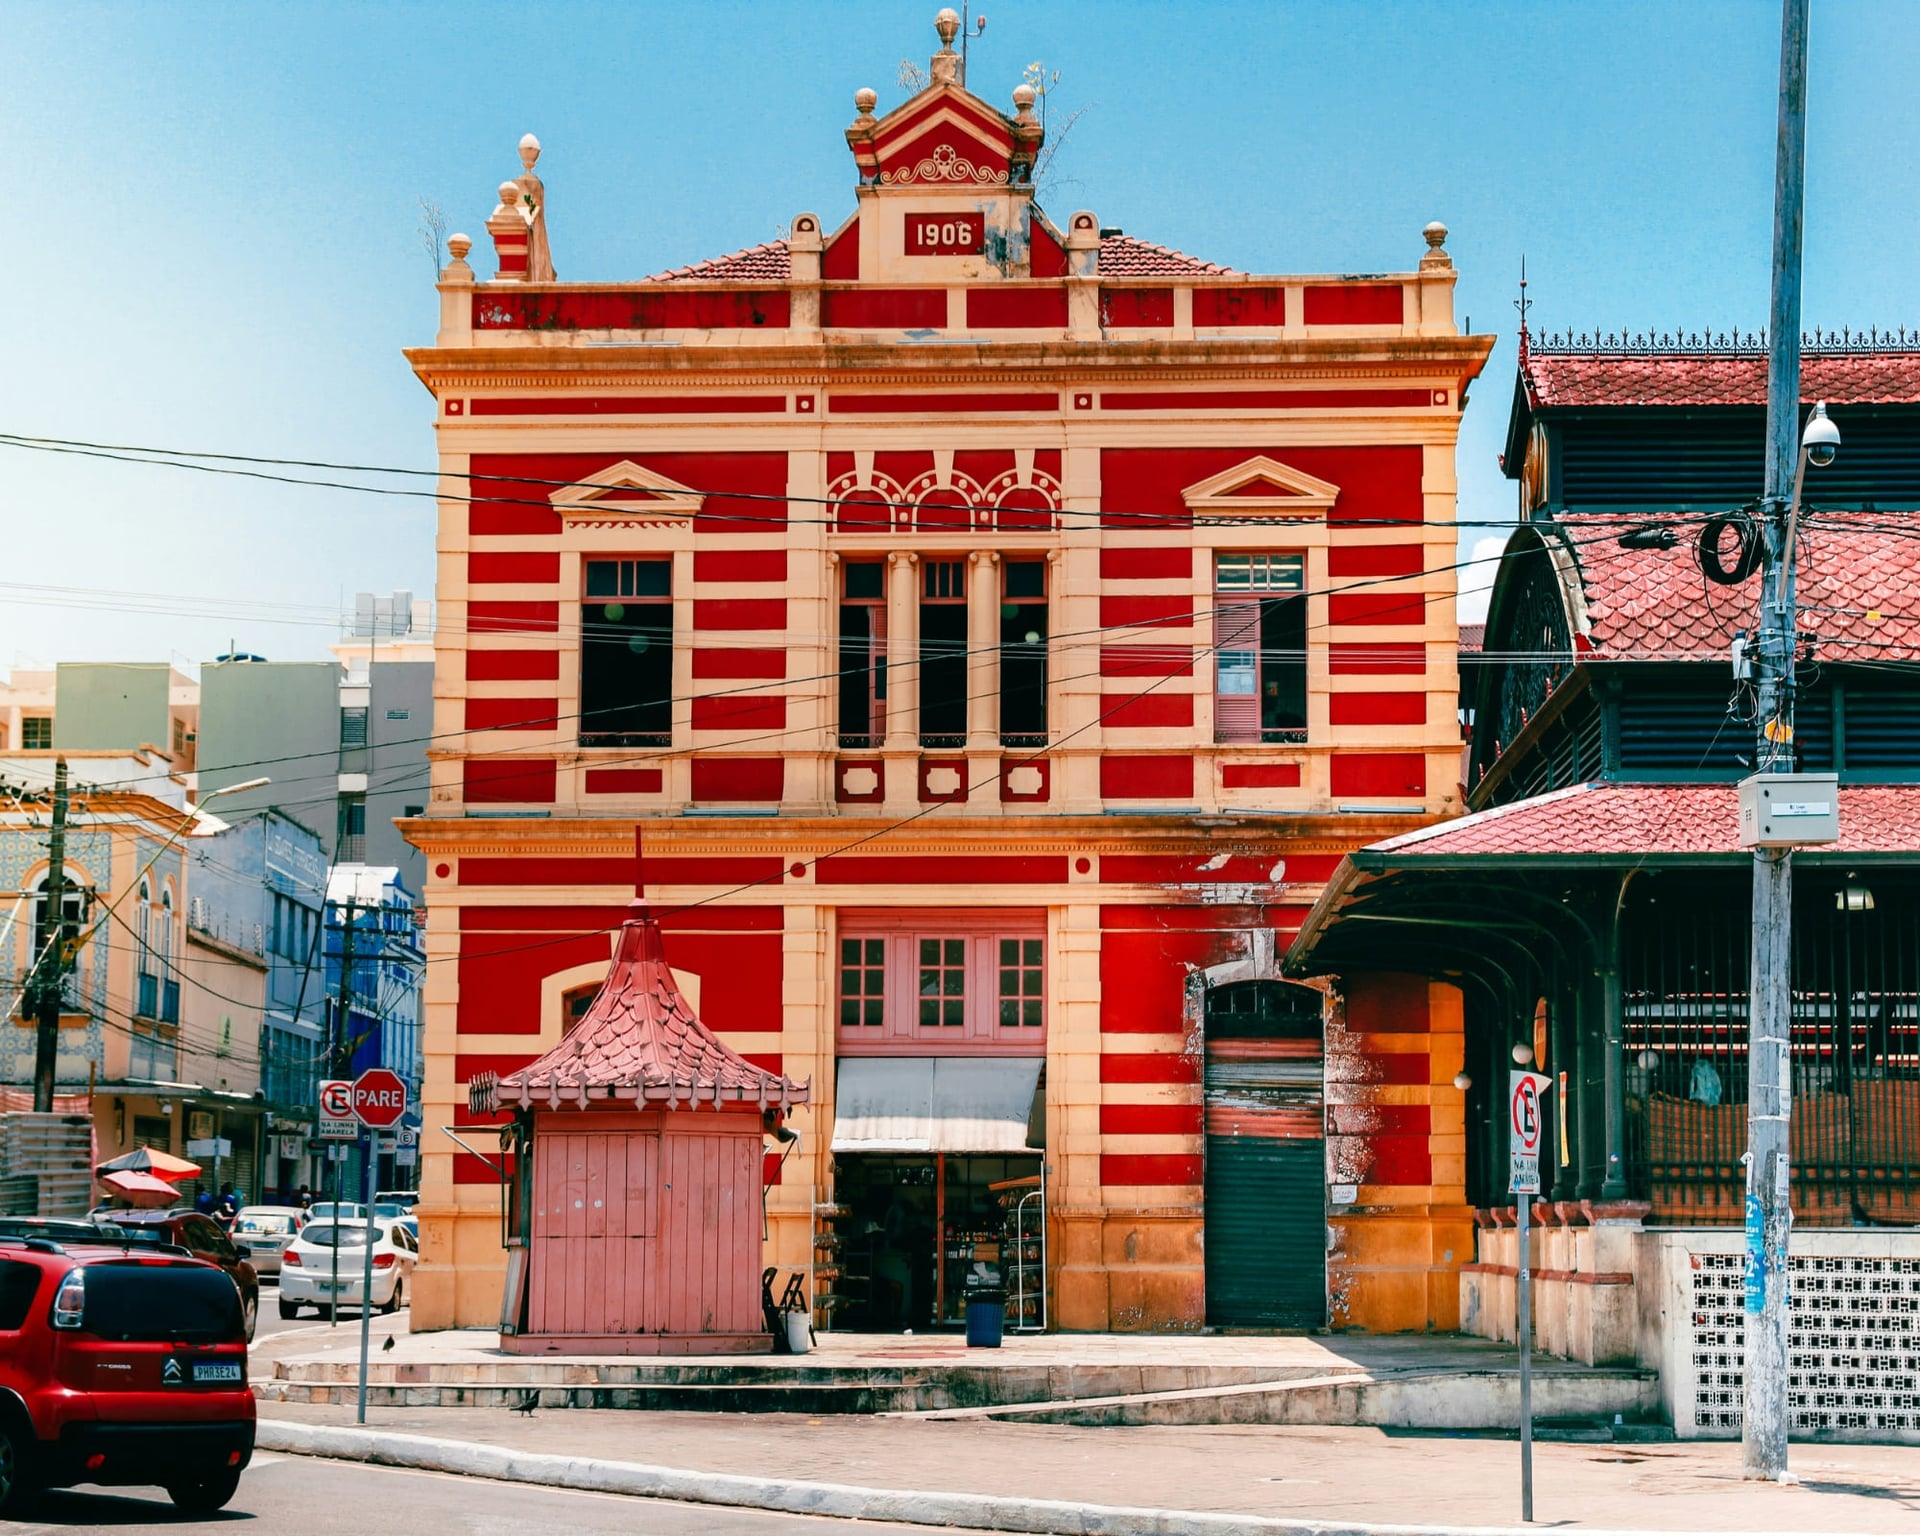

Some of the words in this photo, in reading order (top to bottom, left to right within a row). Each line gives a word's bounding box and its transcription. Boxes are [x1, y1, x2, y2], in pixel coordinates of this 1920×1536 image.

[917, 224, 972, 246] 1906
[355, 1089, 402, 1108] PARE
[321, 1121, 331, 1129] NA
[334, 1121, 354, 1129] LINHA
[321, 1128, 354, 1136] AMARELA
[197, 1365, 237, 1380] PHR3E24
